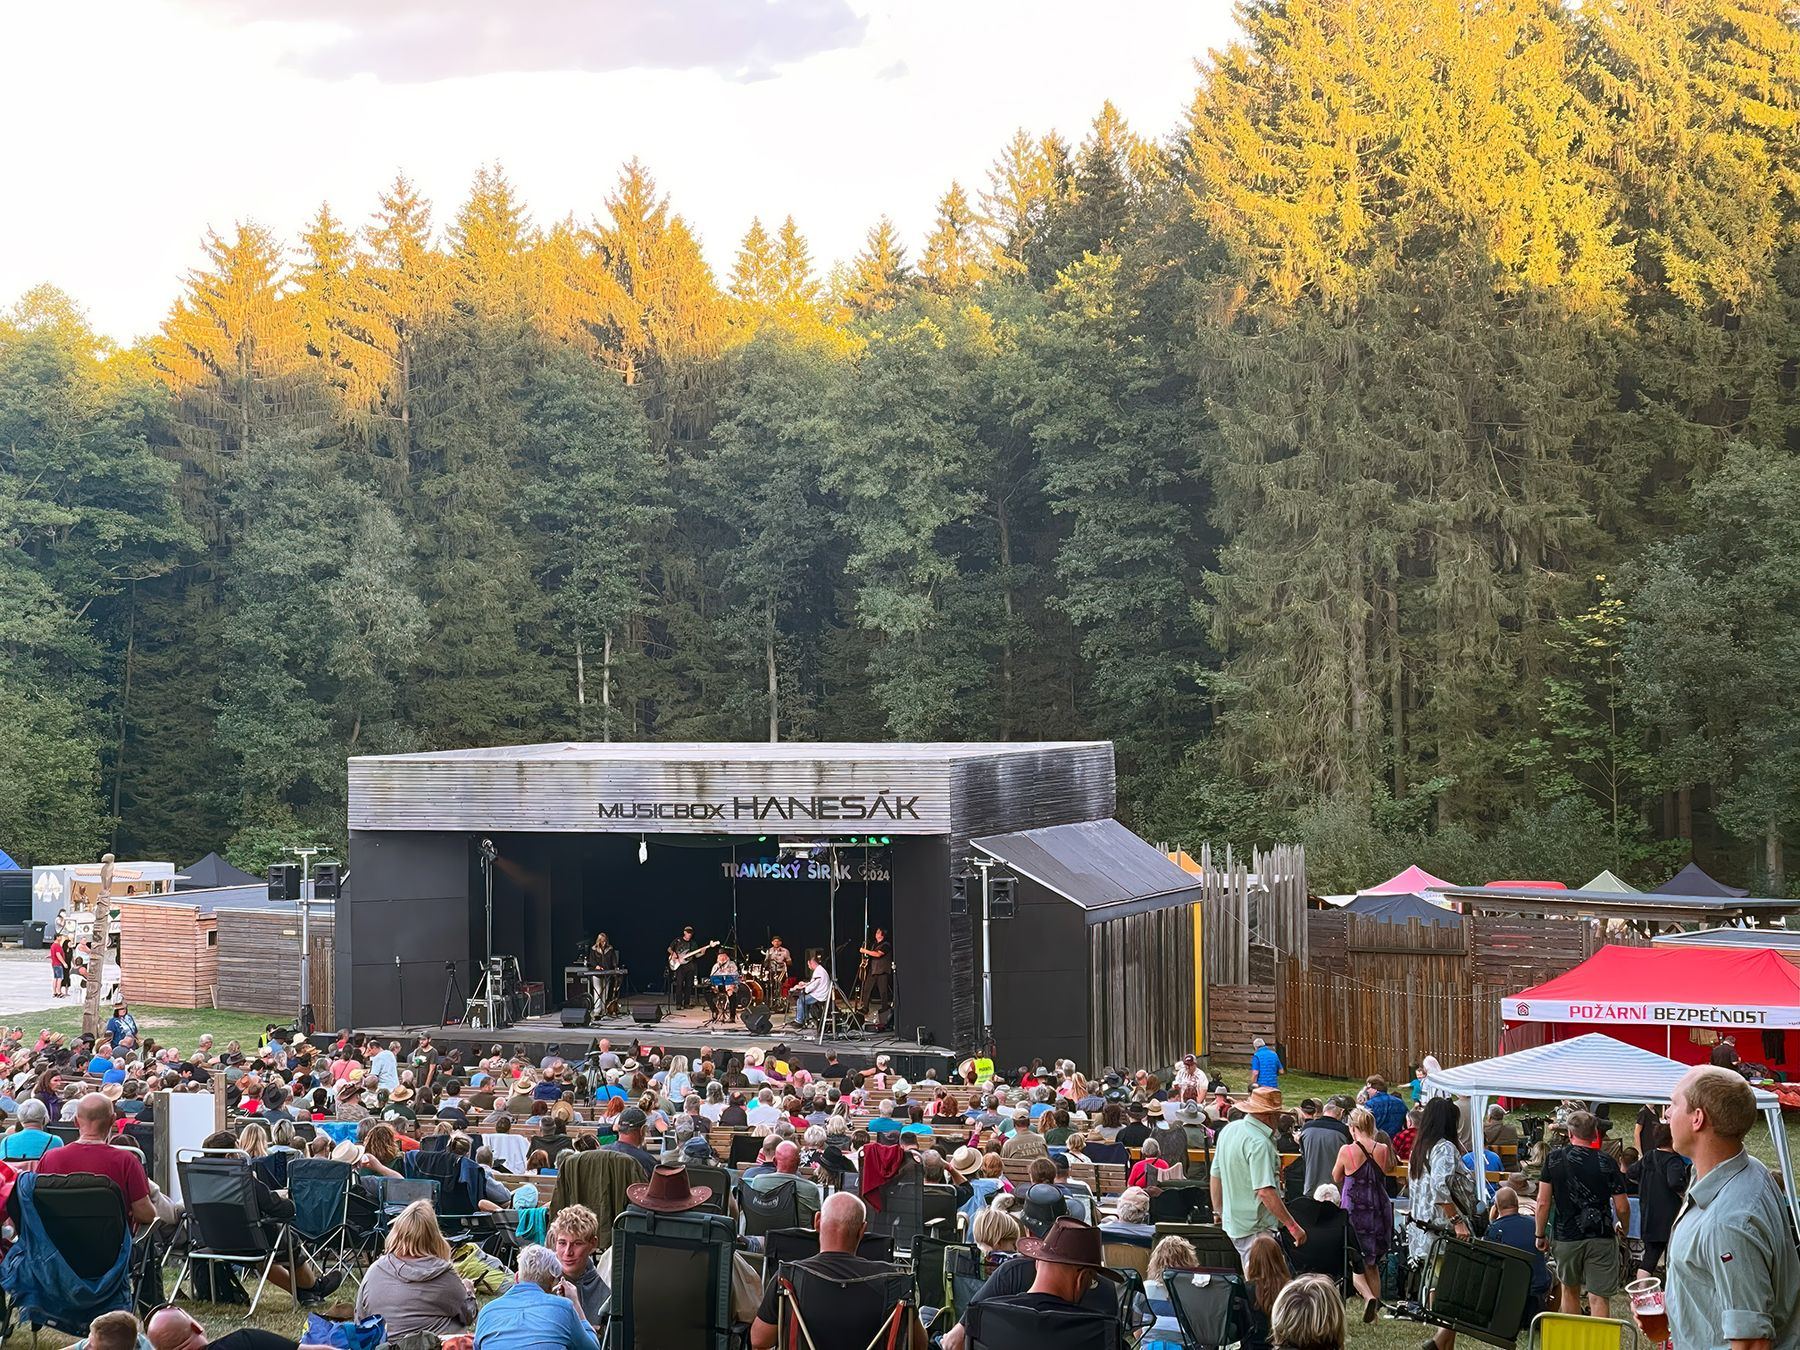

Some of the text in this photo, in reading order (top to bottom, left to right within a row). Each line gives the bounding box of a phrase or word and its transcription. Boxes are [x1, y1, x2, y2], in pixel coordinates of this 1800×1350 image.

[598, 789, 920, 820] MUSICBOX HANESÁK
[721, 859, 801, 879] TRAMPSKÝ
[862, 869, 890, 881] 2024
[1569, 1004, 1767, 1024] POŽÁRNÍ BEZPEČNOST
